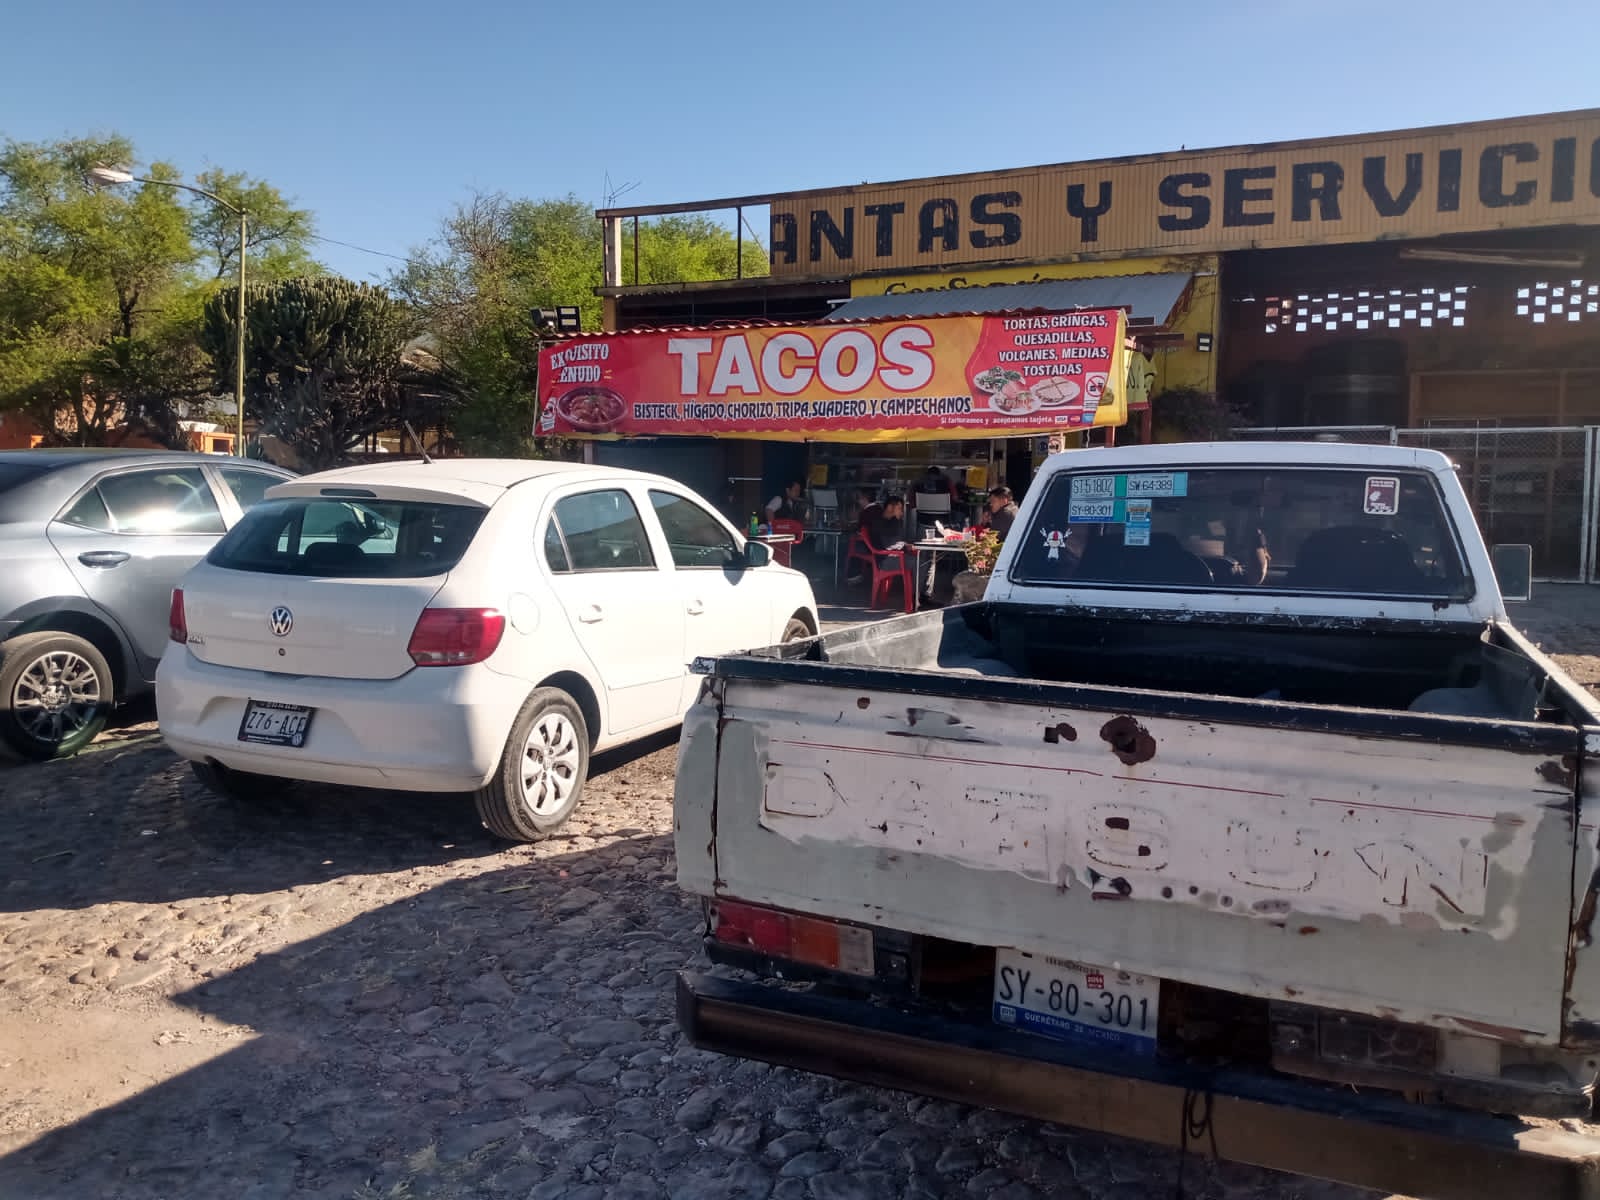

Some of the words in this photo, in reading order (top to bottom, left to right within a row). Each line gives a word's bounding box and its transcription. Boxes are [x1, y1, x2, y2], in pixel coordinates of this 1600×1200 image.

[1067, 182, 1112, 242] Y
[1157, 136, 1600, 232] SERVICI
[1051, 315, 1108, 328] GRINGAS,
[1014, 331, 1095, 346] QUESADILLAS,
[667, 326, 935, 396] TACOS
[999, 349, 1058, 362] VOLCANES,
[1062, 347, 1110, 360] MEDIAS,
[557, 364, 602, 383] ENUDO
[1023, 363, 1082, 377] TOSTADAS
[633, 404, 681, 419] BISTECK,
[869, 399, 879, 416] Y
[880, 397, 972, 416] CAMPECHANOS
[1000, 966, 1149, 1031] SY-80-301
